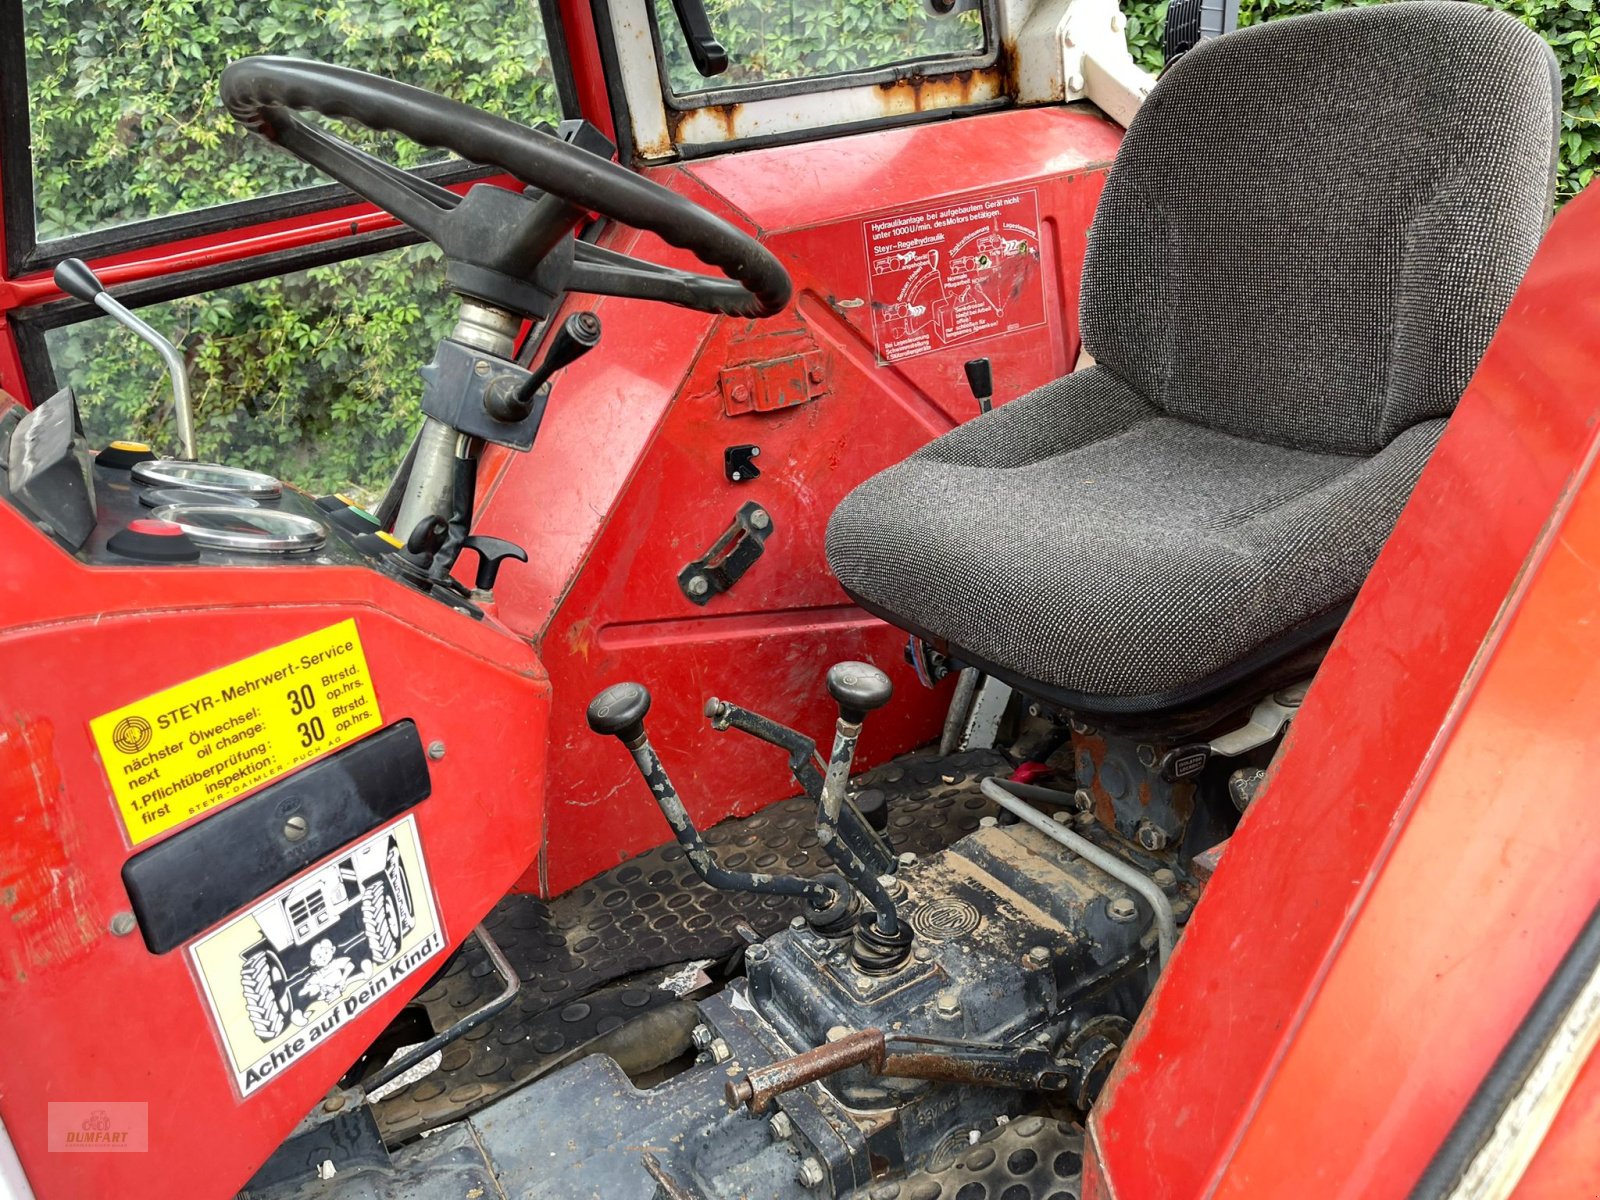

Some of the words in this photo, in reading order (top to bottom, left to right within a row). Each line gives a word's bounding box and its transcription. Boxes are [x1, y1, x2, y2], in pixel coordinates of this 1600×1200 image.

[871, 215, 924, 232] Hydraulikanlage
[926, 212, 938, 221] bei
[939, 204, 983, 218] aufgebautem
[984, 199, 1003, 209] Gerät
[1004, 196, 1019, 205] nicht
[872, 232, 891, 240] unter
[969, 210, 1002, 221] betätigen.
[123, 741, 184, 775] nächster
[189, 707, 262, 745] Ölwechsel:
[287, 684, 316, 716] 30
[321, 664, 360, 687] Btrstd.
[156, 640, 354, 730] STEYR-Mehrwert-Service
[297, 716, 325, 748] 30
[332, 695, 368, 718] Btrstd.
[128, 767, 161, 790] next
[197, 744, 213, 759] oil
[215, 722, 267, 751] change:
[326, 679, 364, 700] op.hrs.
[141, 803, 171, 825] first
[336, 710, 373, 732] op.hrs.
[327, 736, 342, 747] AG
[245, 1036, 306, 1090] Achte
[309, 1007, 341, 1042] auf
[343, 985, 388, 1016] Dein
